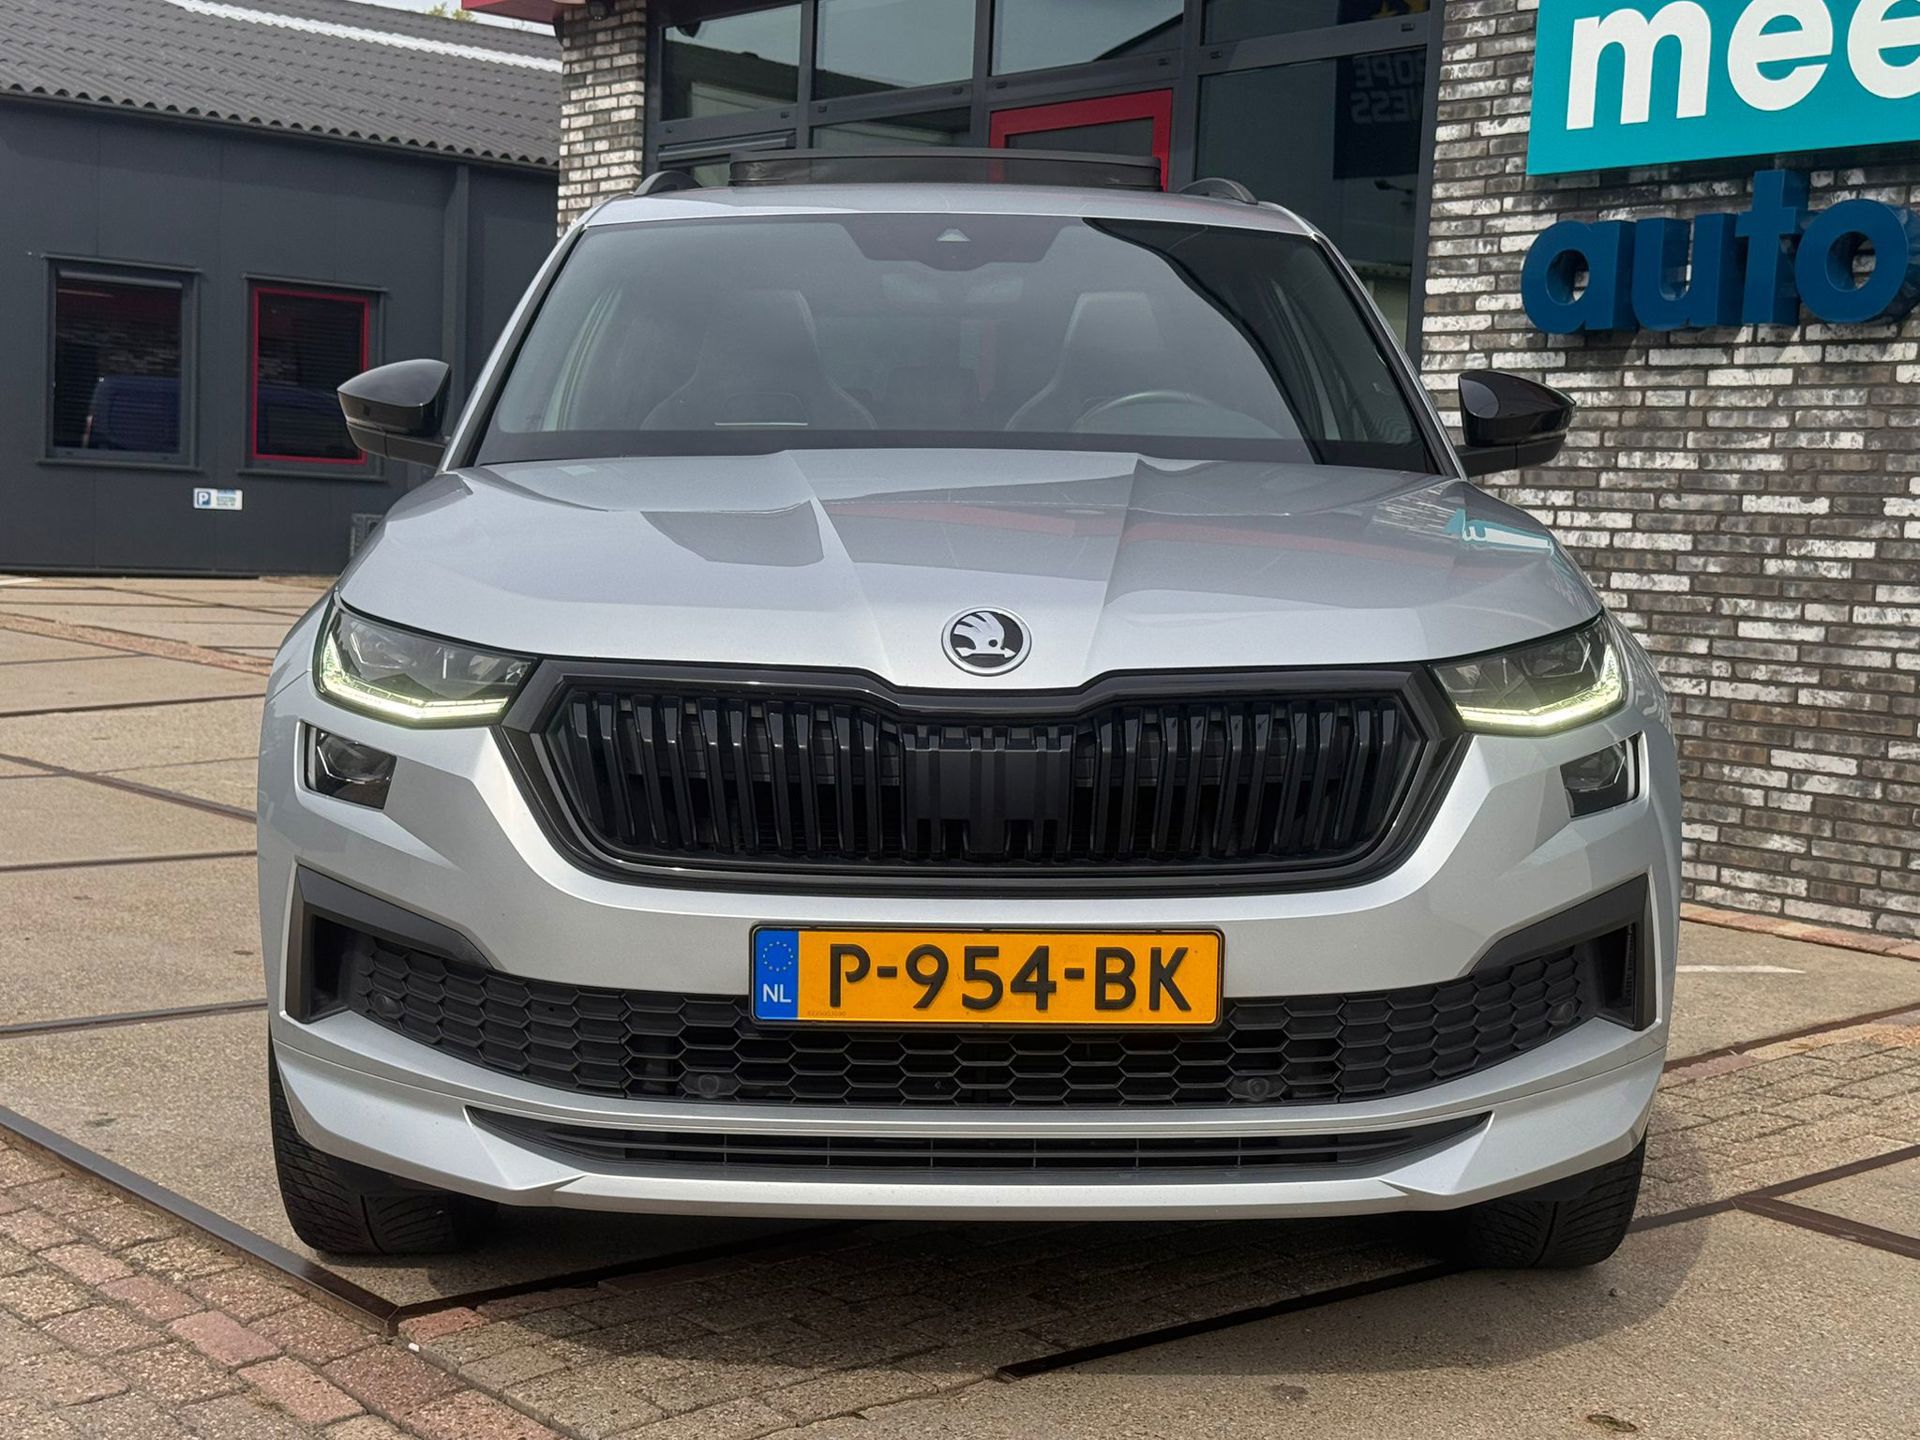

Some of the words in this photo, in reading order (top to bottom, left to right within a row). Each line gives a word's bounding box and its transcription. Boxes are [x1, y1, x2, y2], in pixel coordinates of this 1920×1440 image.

[1521, 169, 1915, 335] auto
[198, 492, 209, 506] P
[762, 983, 792, 1003] NL
[829, 943, 1193, 1012] P-954-BK
